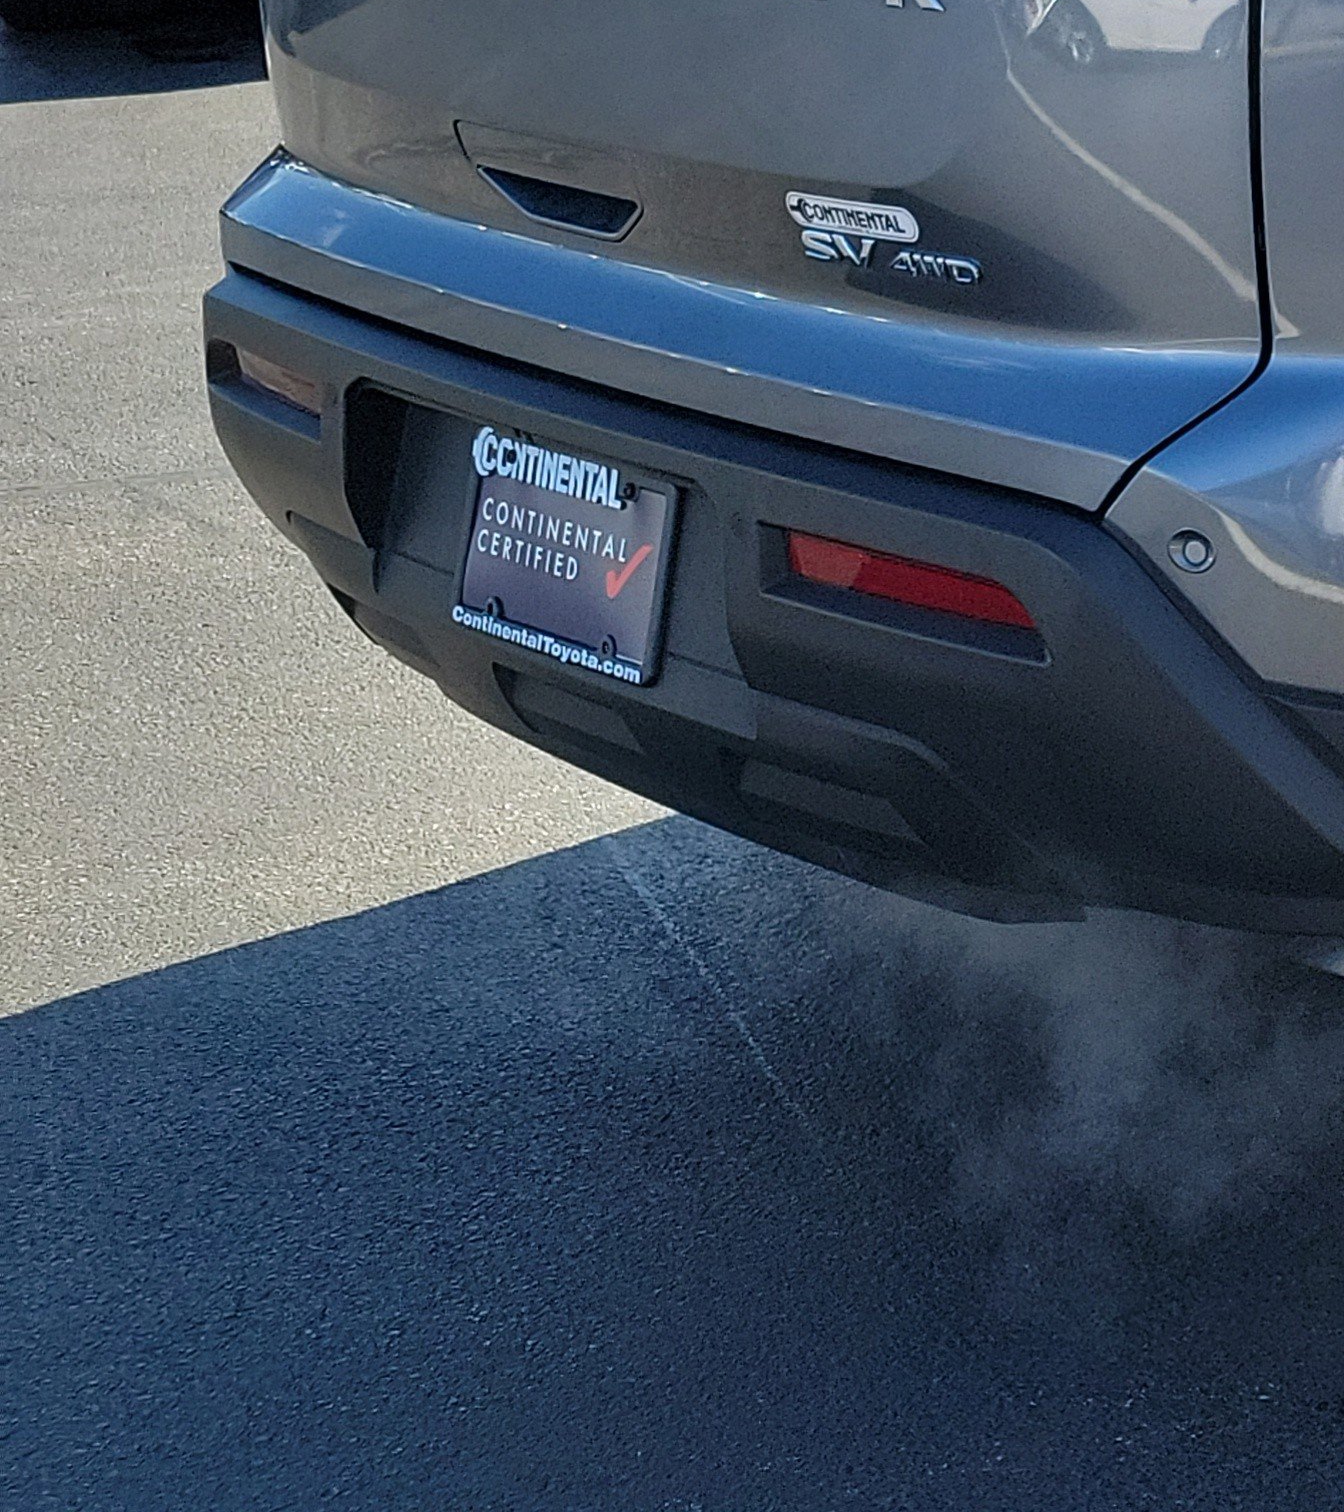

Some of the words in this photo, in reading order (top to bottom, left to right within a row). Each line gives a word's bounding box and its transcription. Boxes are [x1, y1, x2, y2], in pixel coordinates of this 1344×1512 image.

[801, 199, 906, 234] CONTINENTAL
[801, 229, 875, 270] SV
[889, 247, 983, 285] 4WD
[477, 528, 579, 581] CERTIFIED
[482, 497, 627, 563] CONTINENTAL
[452, 604, 642, 684] ContinentalToyota.com
